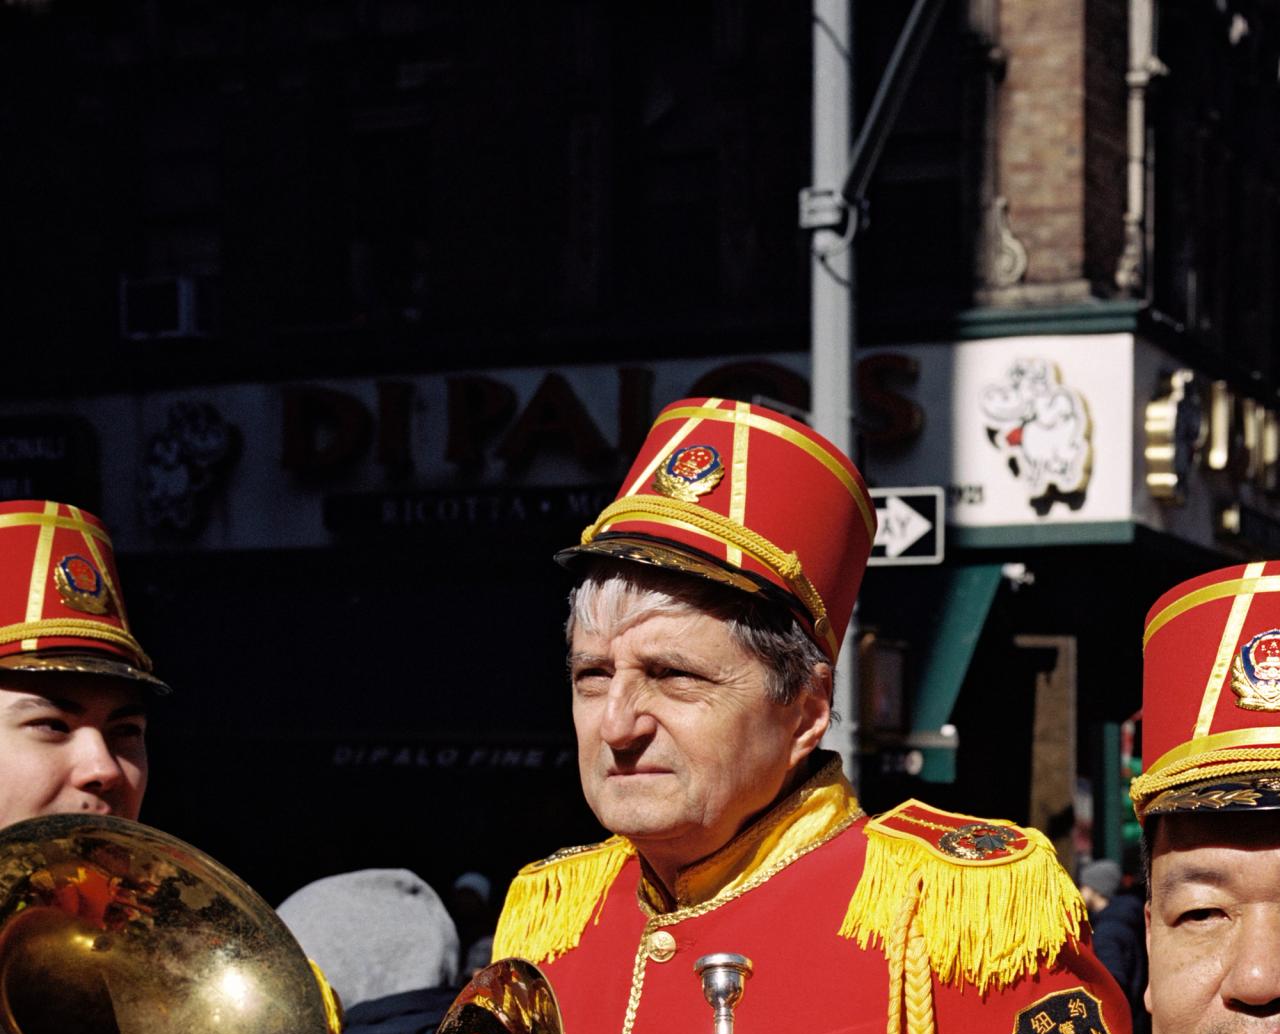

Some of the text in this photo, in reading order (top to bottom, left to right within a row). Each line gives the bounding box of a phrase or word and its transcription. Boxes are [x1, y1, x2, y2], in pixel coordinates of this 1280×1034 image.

[281, 383, 411, 476] DI
[381, 496, 526, 523] RICOTTA
[469, 748, 543, 767] FINE
